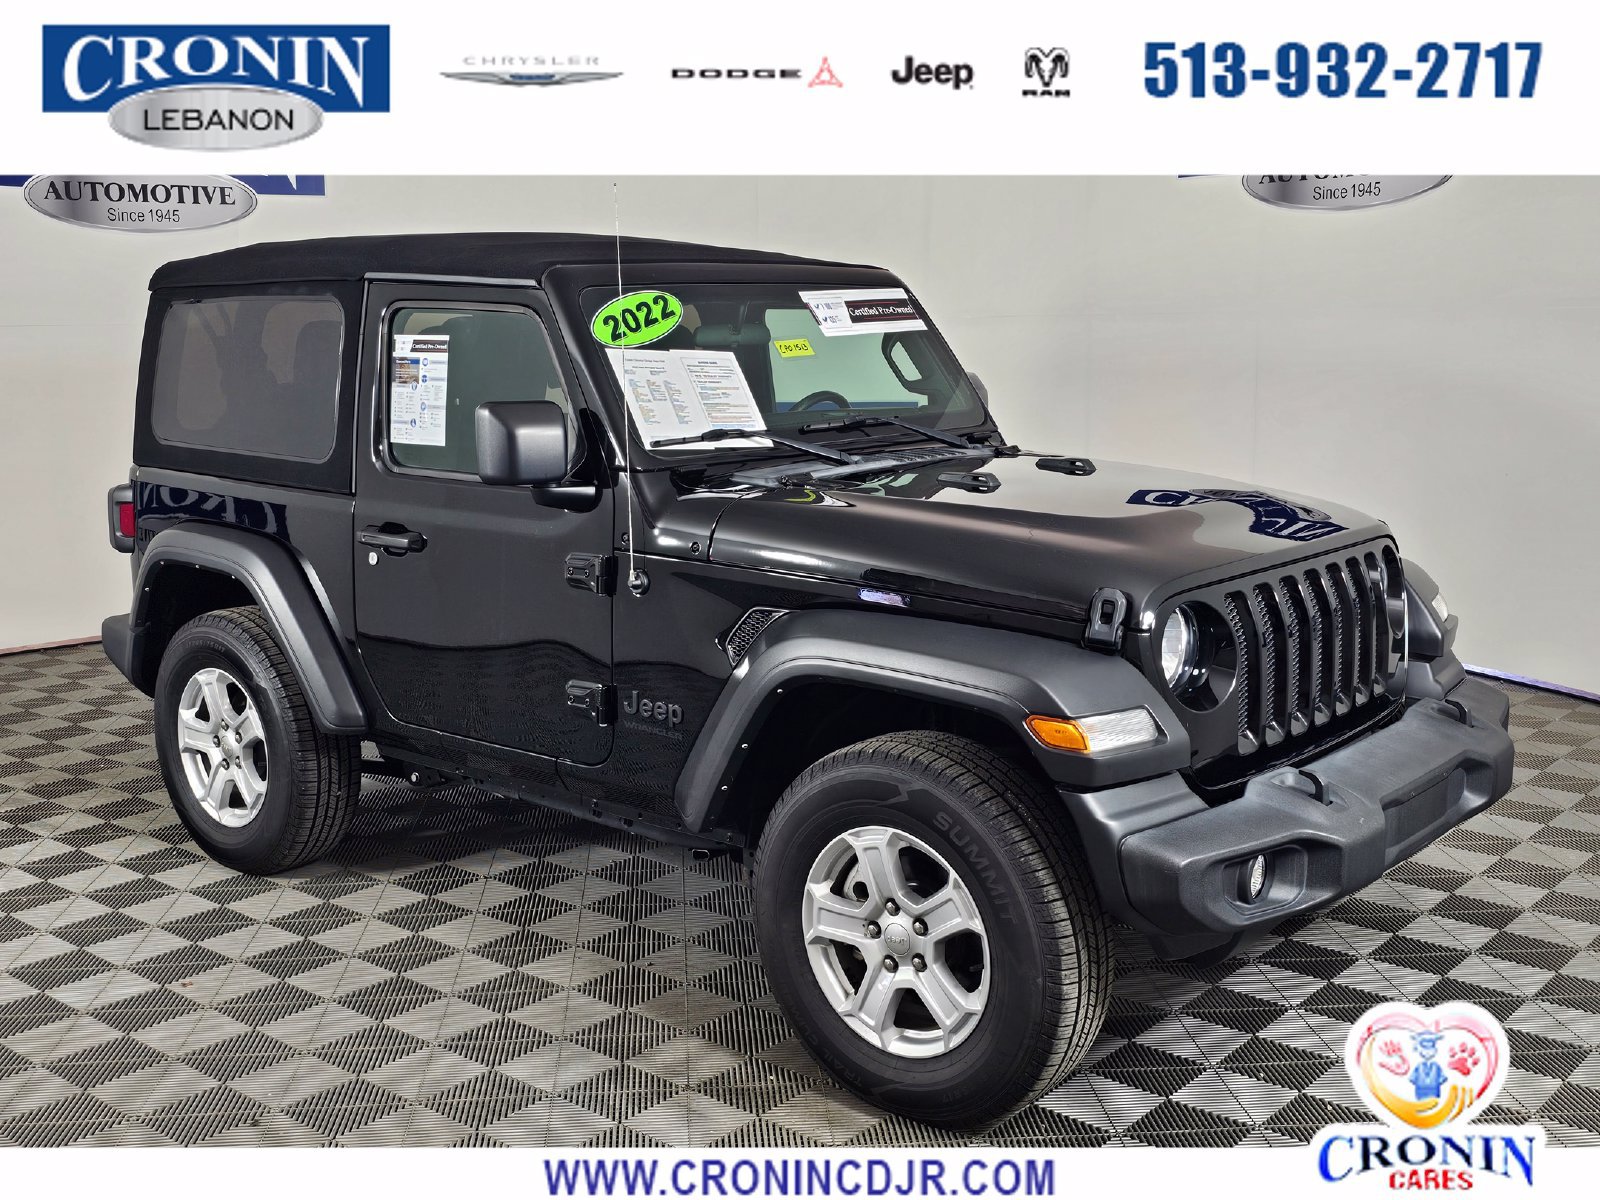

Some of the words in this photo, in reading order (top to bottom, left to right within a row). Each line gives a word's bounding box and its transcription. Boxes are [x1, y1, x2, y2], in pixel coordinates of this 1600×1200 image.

[44, 180, 236, 206] AUTOMOTIVE
[1312, 185, 1348, 201] Since
[1351, 181, 1381, 198] 1945
[107, 207, 145, 222] Since
[148, 208, 181, 223] 1945
[602, 295, 677, 343] 2022
[848, 307, 879, 317] Certified
[879, 306, 914, 315] Pre-Owned
[623, 690, 684, 728] Jeep
[932, 810, 1018, 924] SUMMIT
